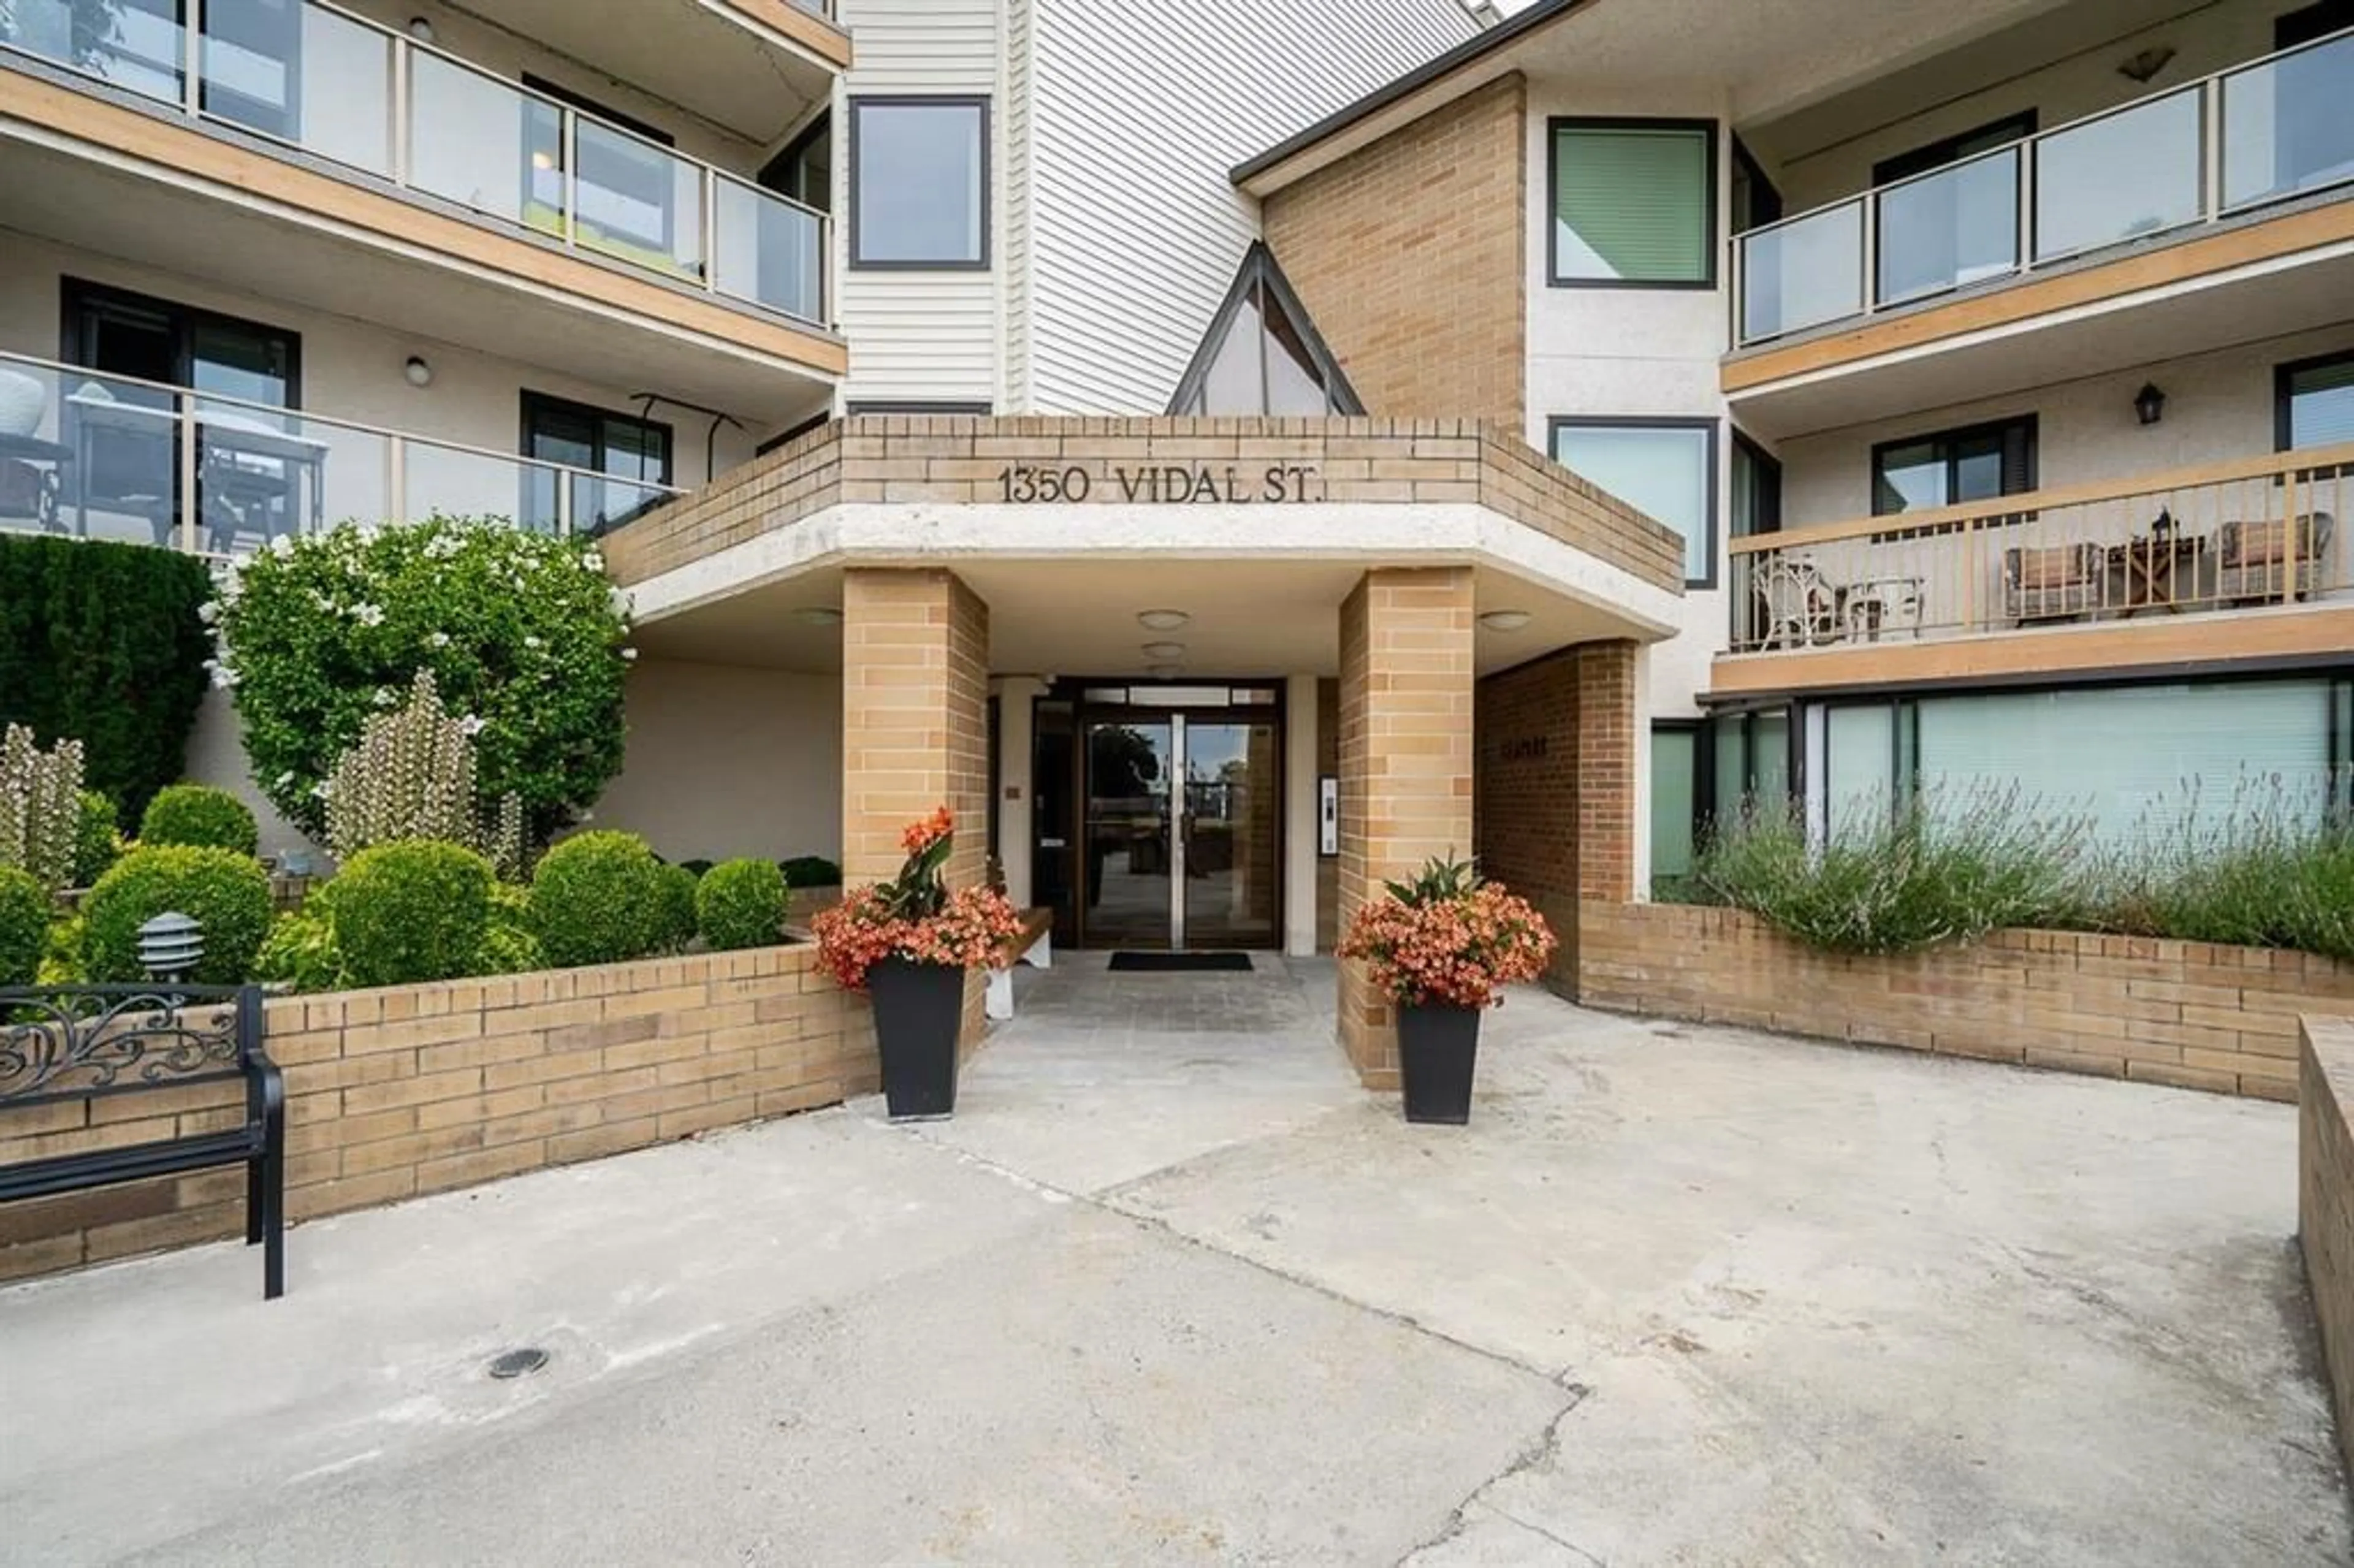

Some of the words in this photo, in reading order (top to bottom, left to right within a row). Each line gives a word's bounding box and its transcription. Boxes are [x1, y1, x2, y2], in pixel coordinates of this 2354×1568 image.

[997, 466, 1090, 503] 1350
[1116, 466, 1251, 503] VIDAL
[1263, 466, 1322, 503] ST.
